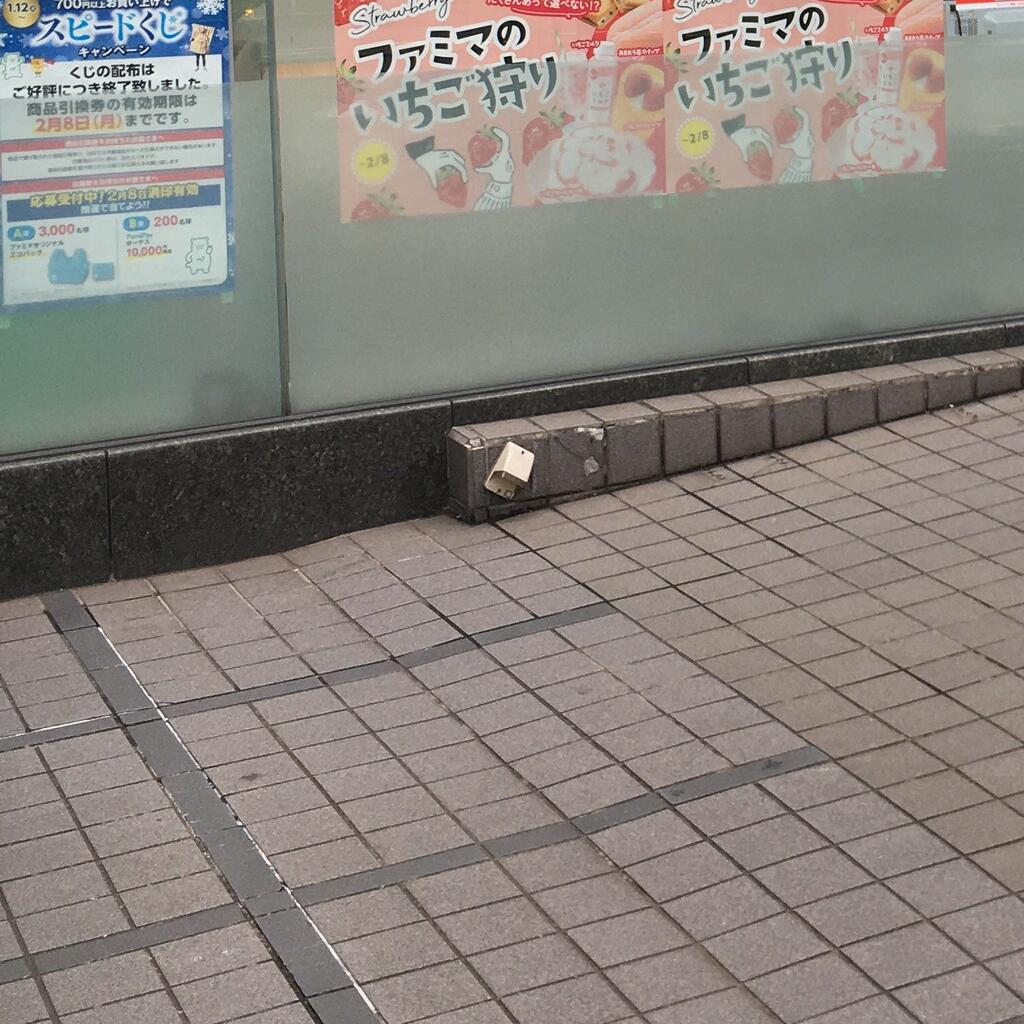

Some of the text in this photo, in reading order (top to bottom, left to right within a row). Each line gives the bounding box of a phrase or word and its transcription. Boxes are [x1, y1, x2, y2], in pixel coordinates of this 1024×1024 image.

[36, 10, 186, 42] スピードくじ
[681, 6, 825, 62] ファミマの
[78, 45, 151, 57] キャンペーン
[357, 19, 528, 80] ファミマの
[69, 63, 155, 79] くじの配布は
[677, 39, 851, 111] いちご狩り
[13, 77, 209, 99] ご好評につき終了致しました。
[353, 54, 559, 131] いちご狩り
[27, 94, 198, 117] 商品引換券の有効期限は
